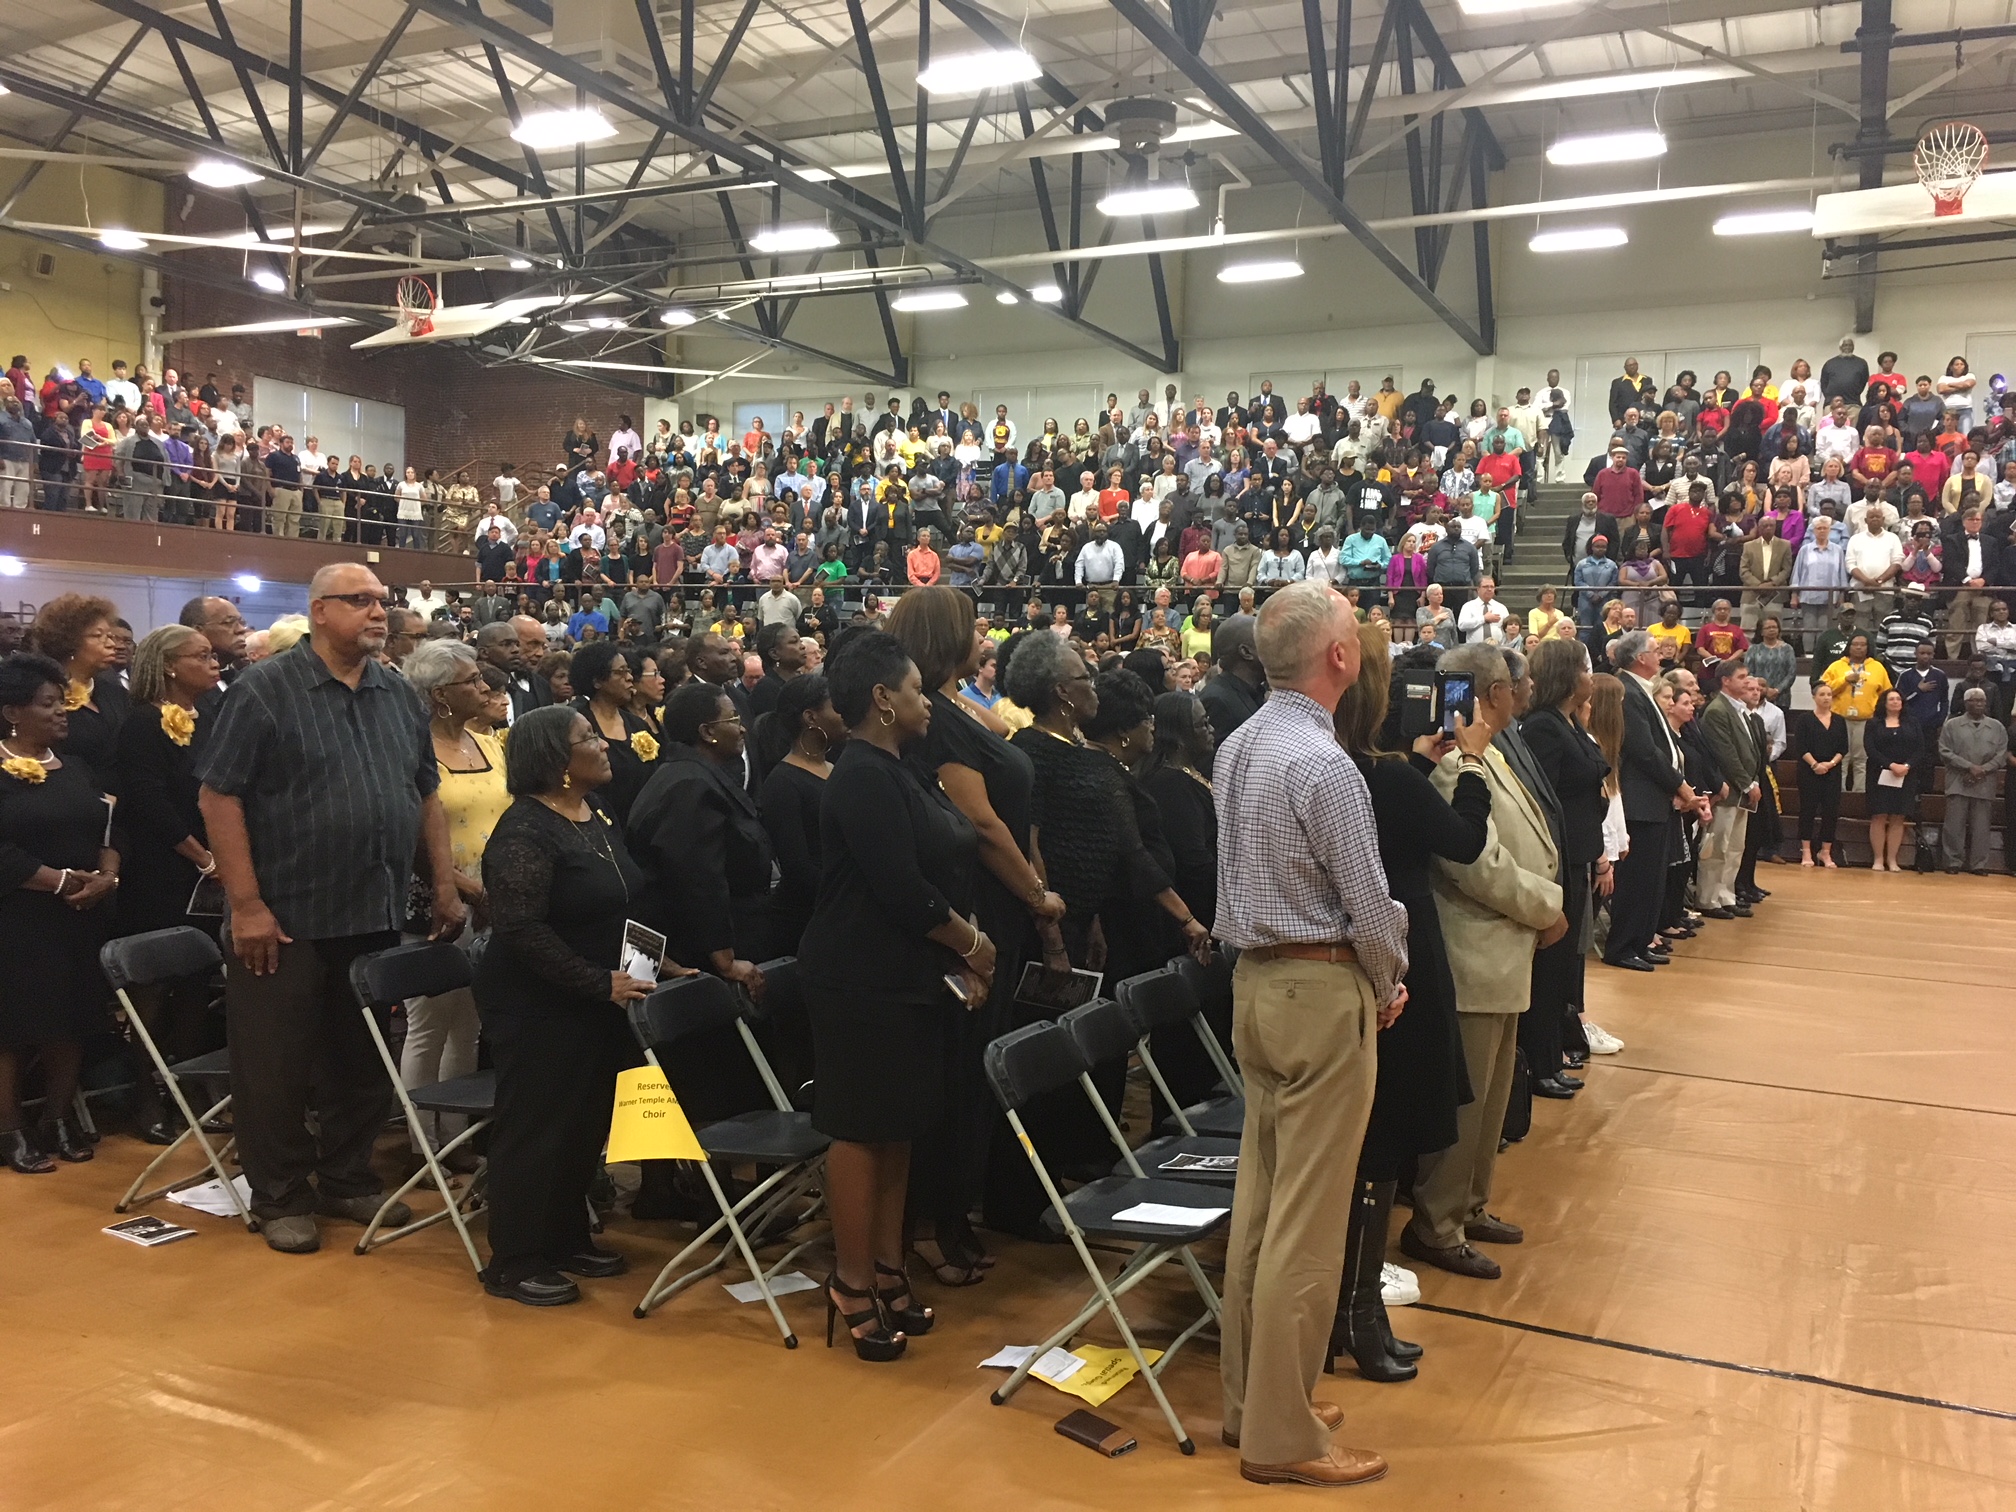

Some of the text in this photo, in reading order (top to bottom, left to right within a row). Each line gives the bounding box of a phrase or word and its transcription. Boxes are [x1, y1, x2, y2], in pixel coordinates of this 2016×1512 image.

[33, 524, 40, 535] H
[637, 1082, 672, 1091] Reserve
[639, 1096, 665, 1105] Temple
[642, 1110, 667, 1119] Choir
